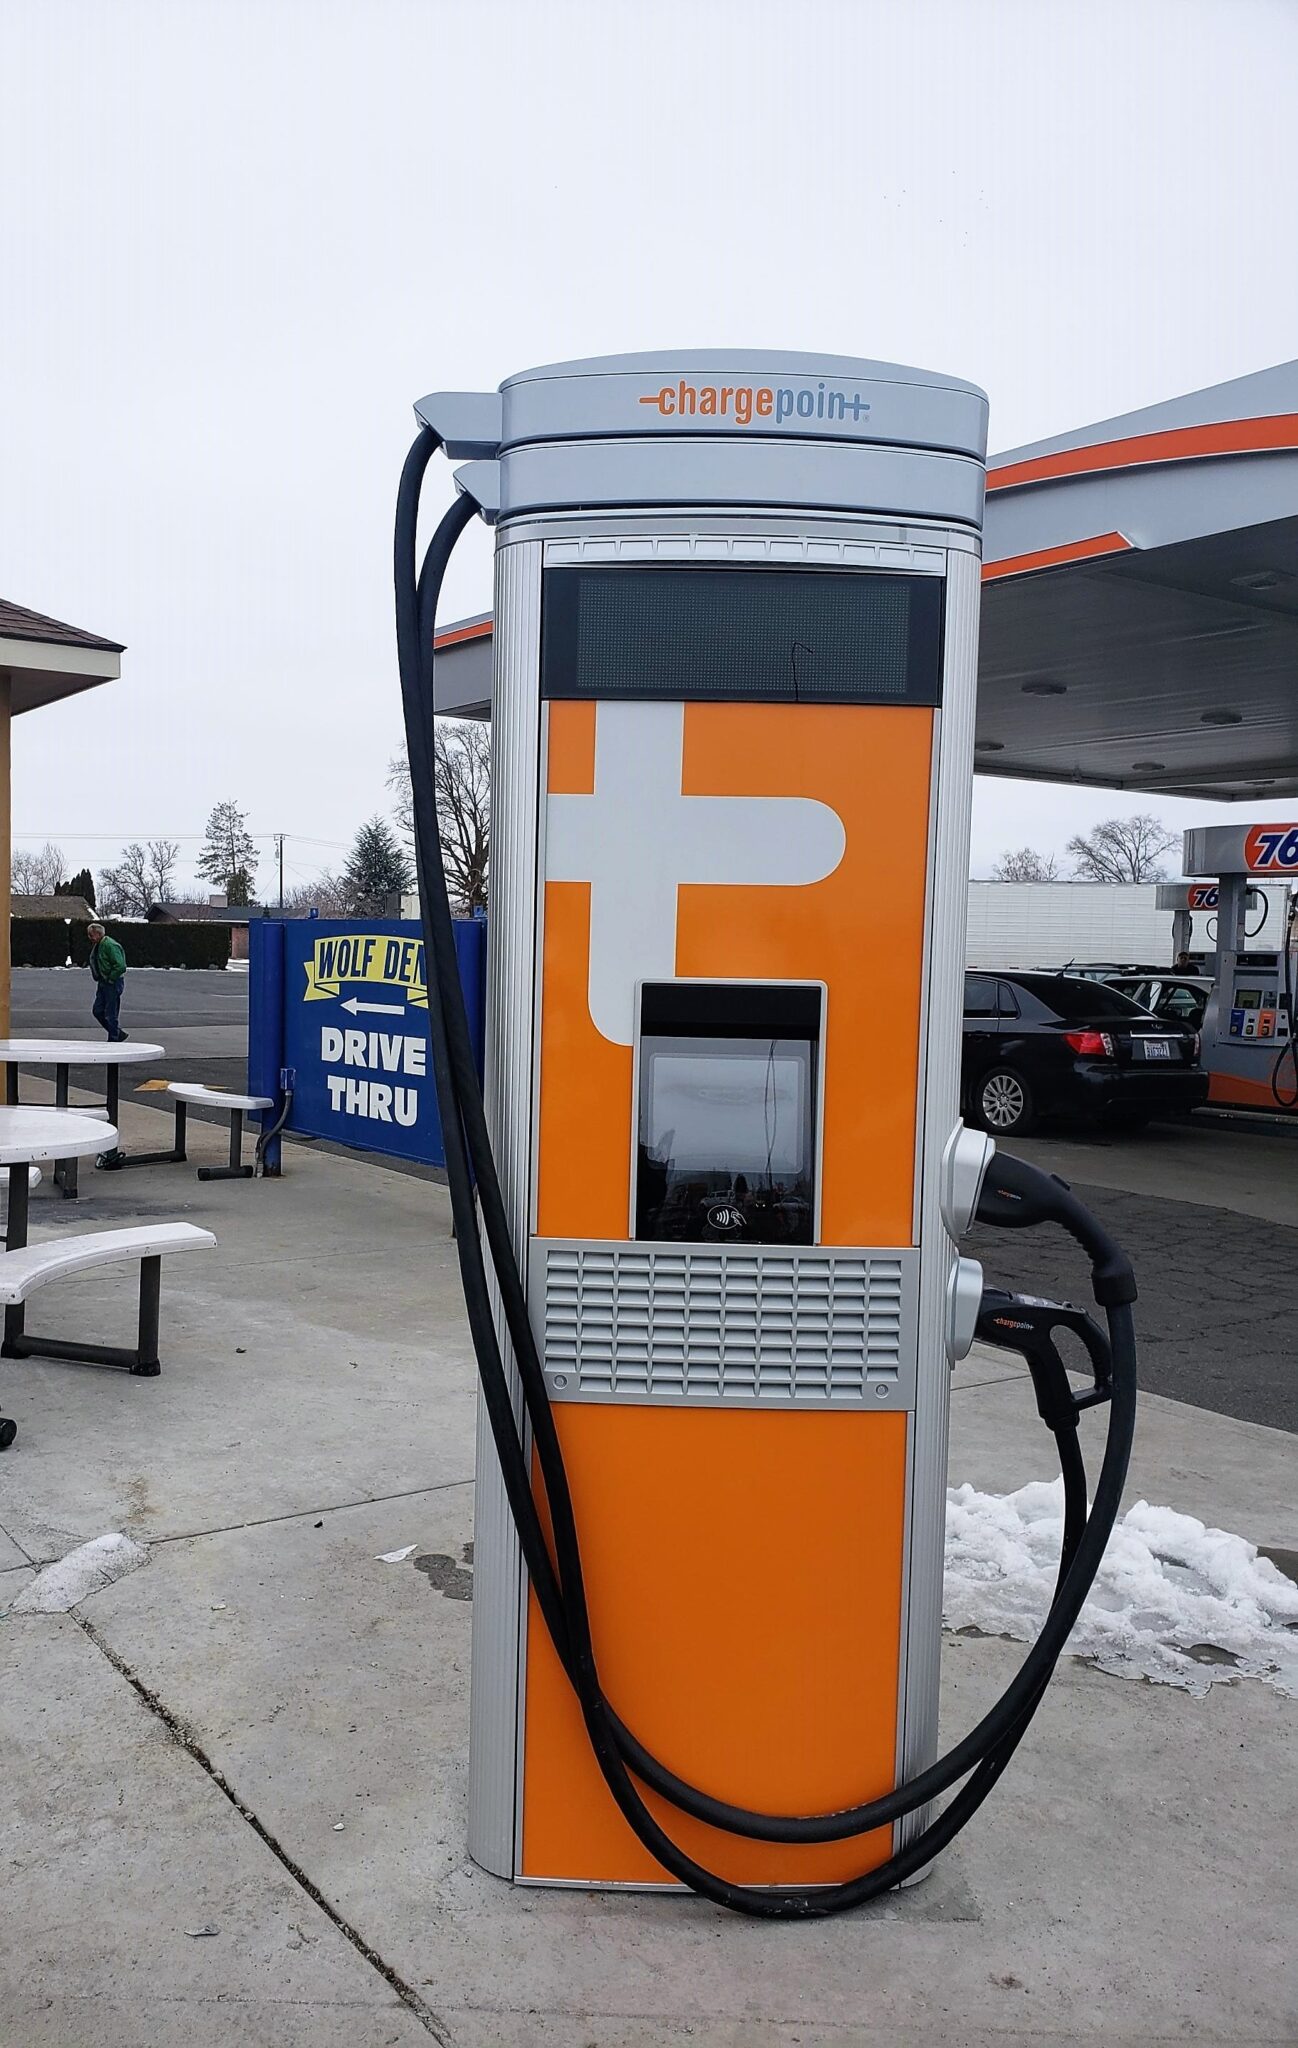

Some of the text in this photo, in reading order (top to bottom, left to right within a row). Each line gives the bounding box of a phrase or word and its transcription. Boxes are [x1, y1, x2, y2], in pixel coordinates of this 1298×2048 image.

[640, 380, 870, 424] chargepoint
[1253, 827, 1298, 868] 76
[1194, 886, 1219, 909] 76
[318, 938, 377, 979] WOLF
[321, 1026, 426, 1077] DRIVE
[327, 1074, 418, 1127] THRU
